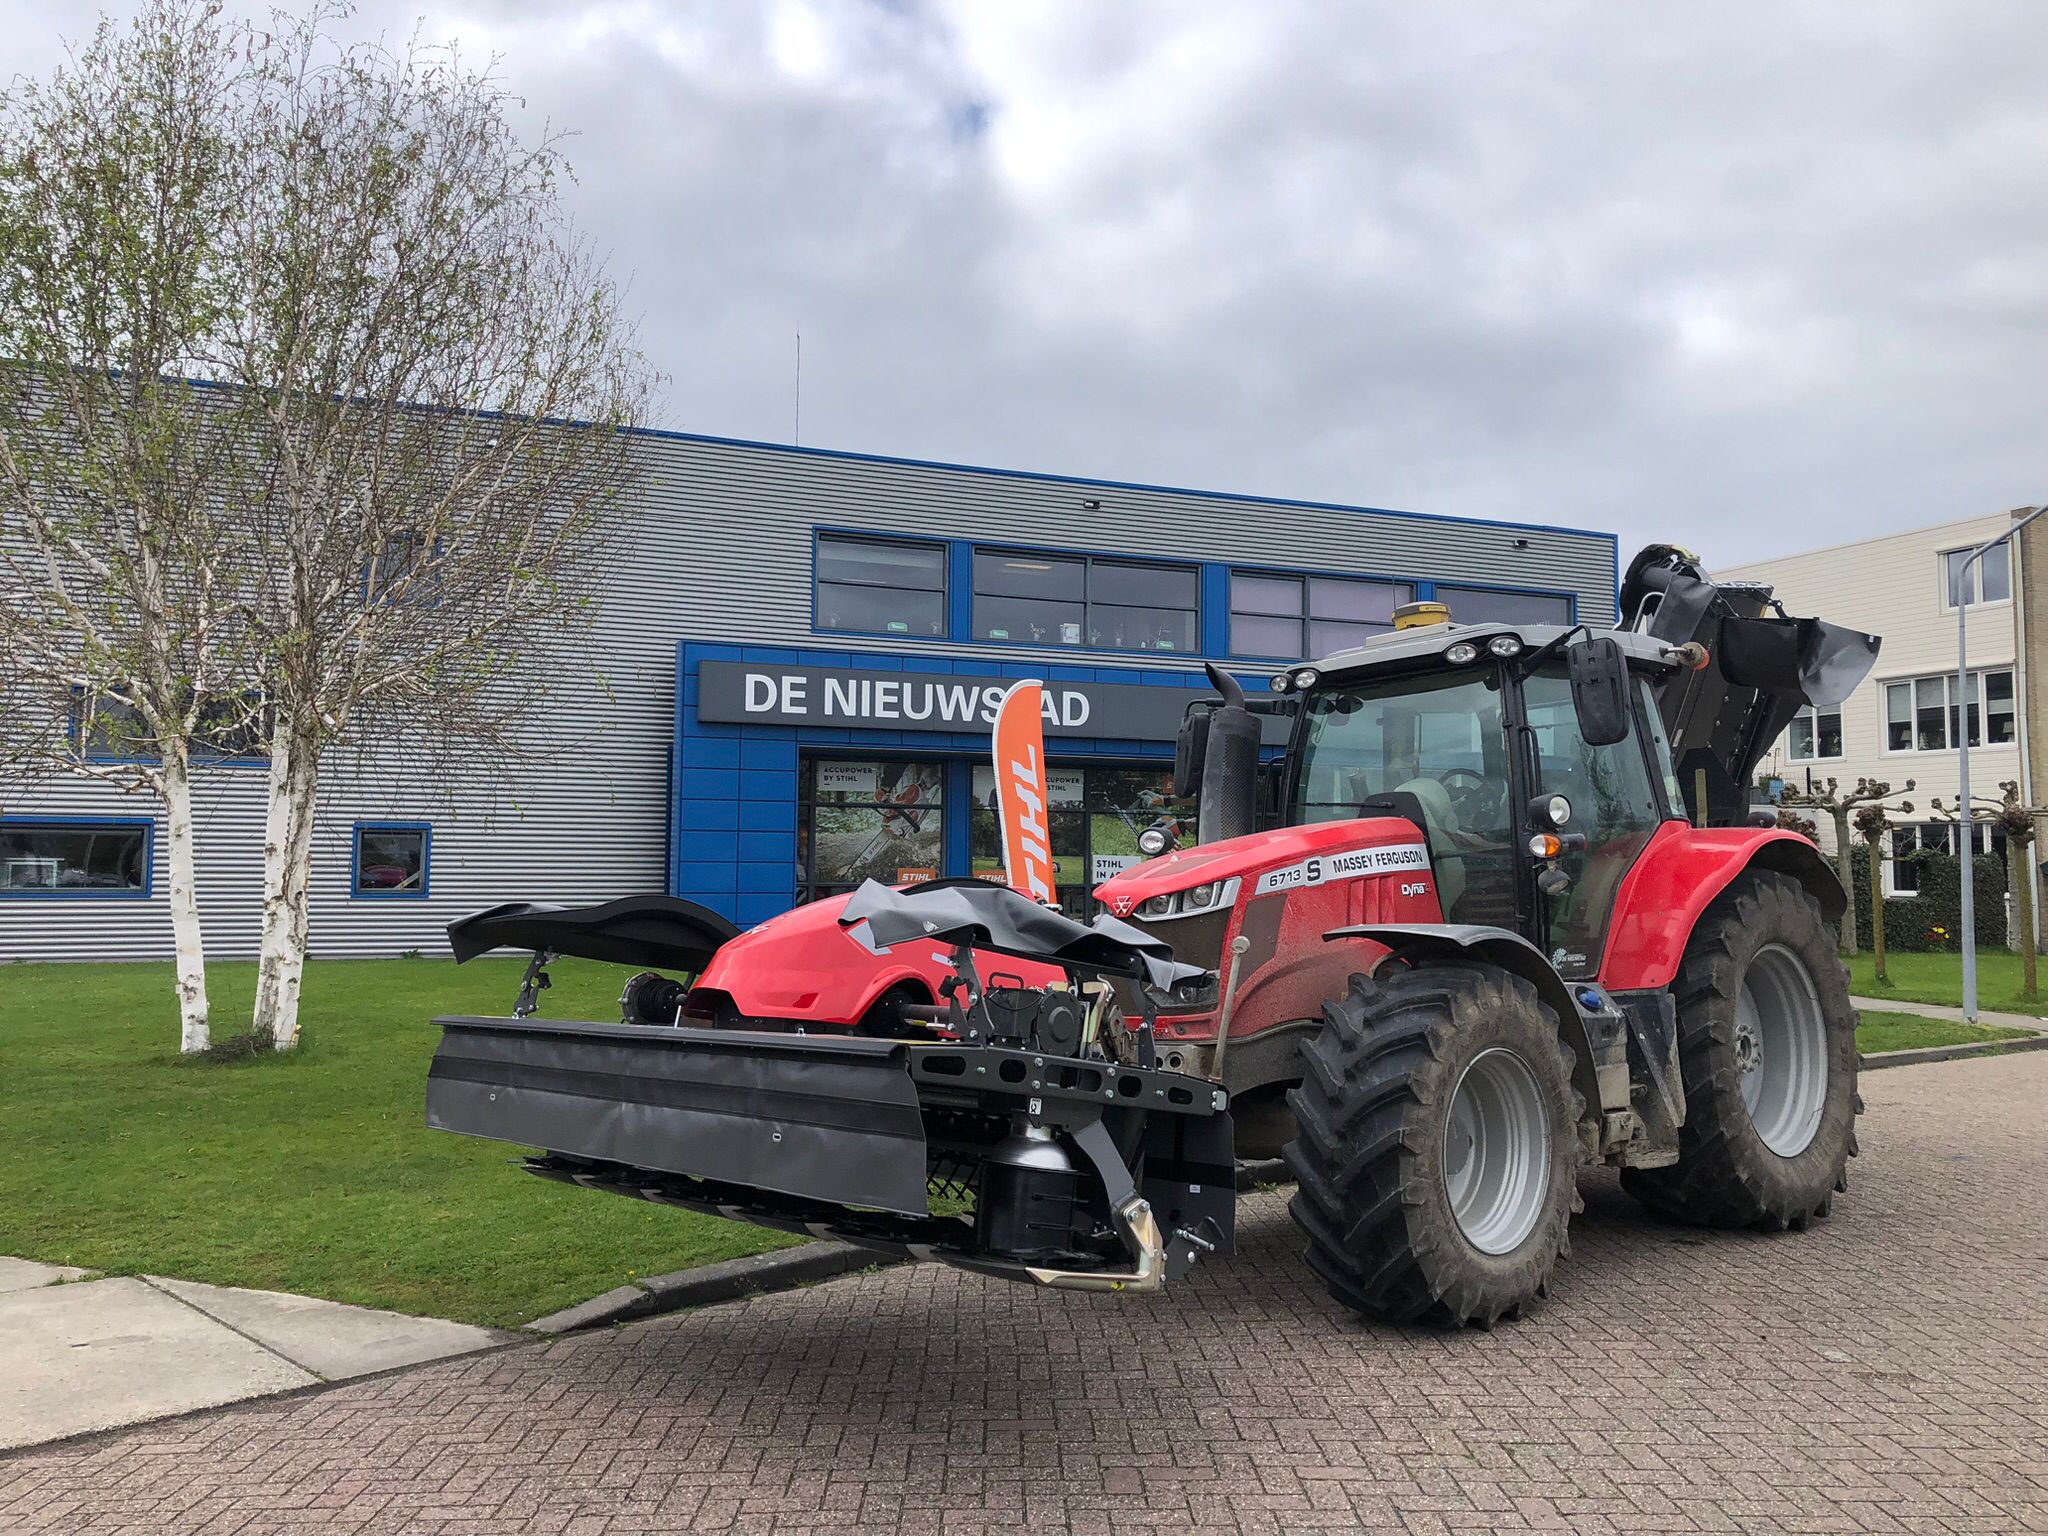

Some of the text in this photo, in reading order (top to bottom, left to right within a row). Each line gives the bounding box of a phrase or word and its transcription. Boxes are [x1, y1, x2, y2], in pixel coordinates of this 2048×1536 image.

[745, 673, 1091, 727] DE NIEUWSAD
[823, 766, 873, 774] ACCUPOWER
[1011, 744, 1050, 903] TIHL
[1096, 860, 1123, 868] STIHL
[1332, 850, 1423, 874] MASSEY FERGUSON
[901, 873, 932, 881] STIHL
[1096, 871, 1107, 879] IN
[1268, 859, 1321, 887] 6713 S
